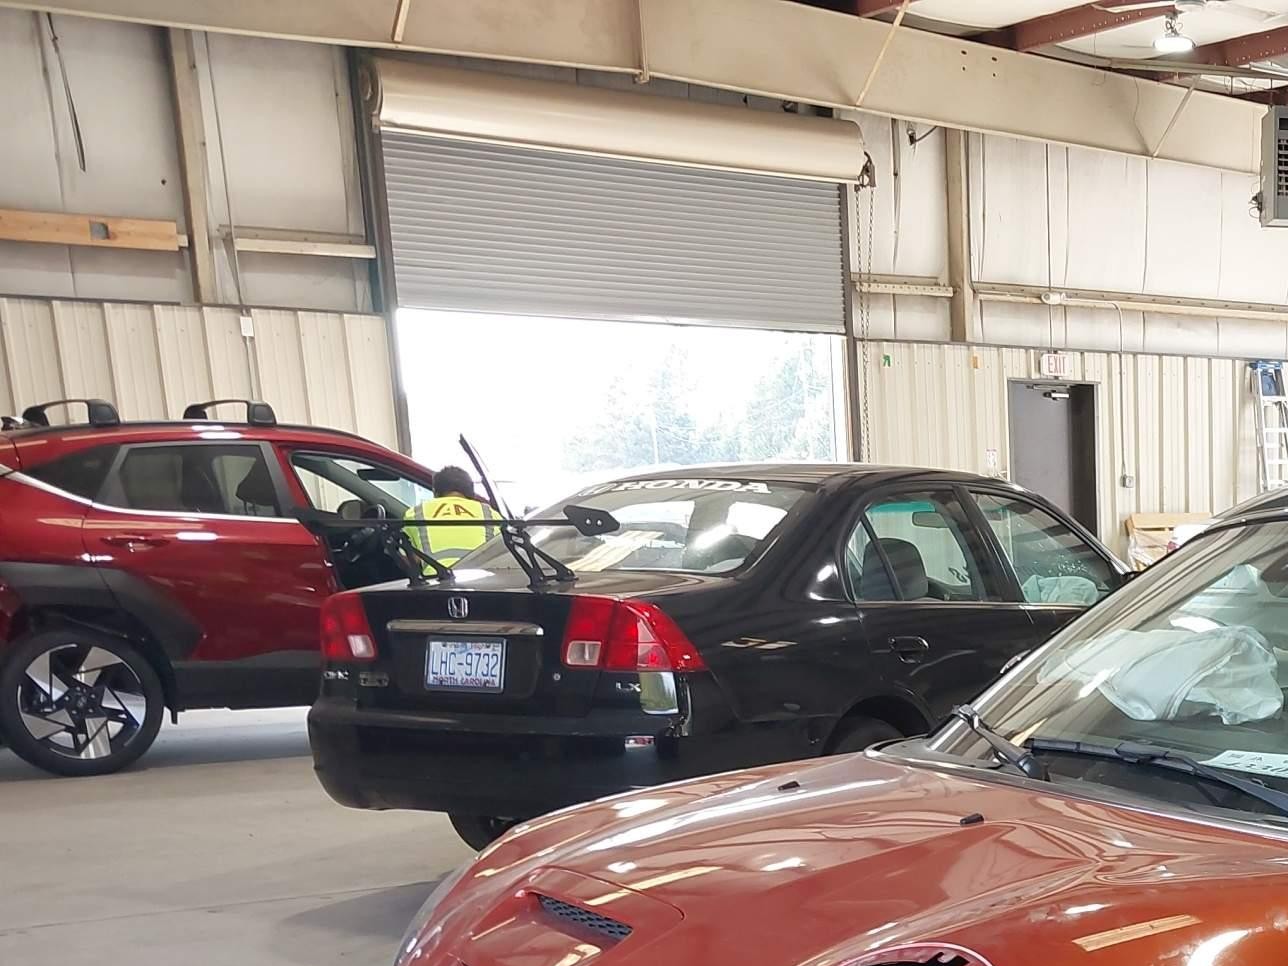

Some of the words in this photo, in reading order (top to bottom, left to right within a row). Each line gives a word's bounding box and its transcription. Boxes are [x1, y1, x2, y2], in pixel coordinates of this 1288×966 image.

[1047, 355, 1066, 374] EXIT
[610, 478, 772, 495] HONDA
[431, 651, 499, 677] LHC-9732
